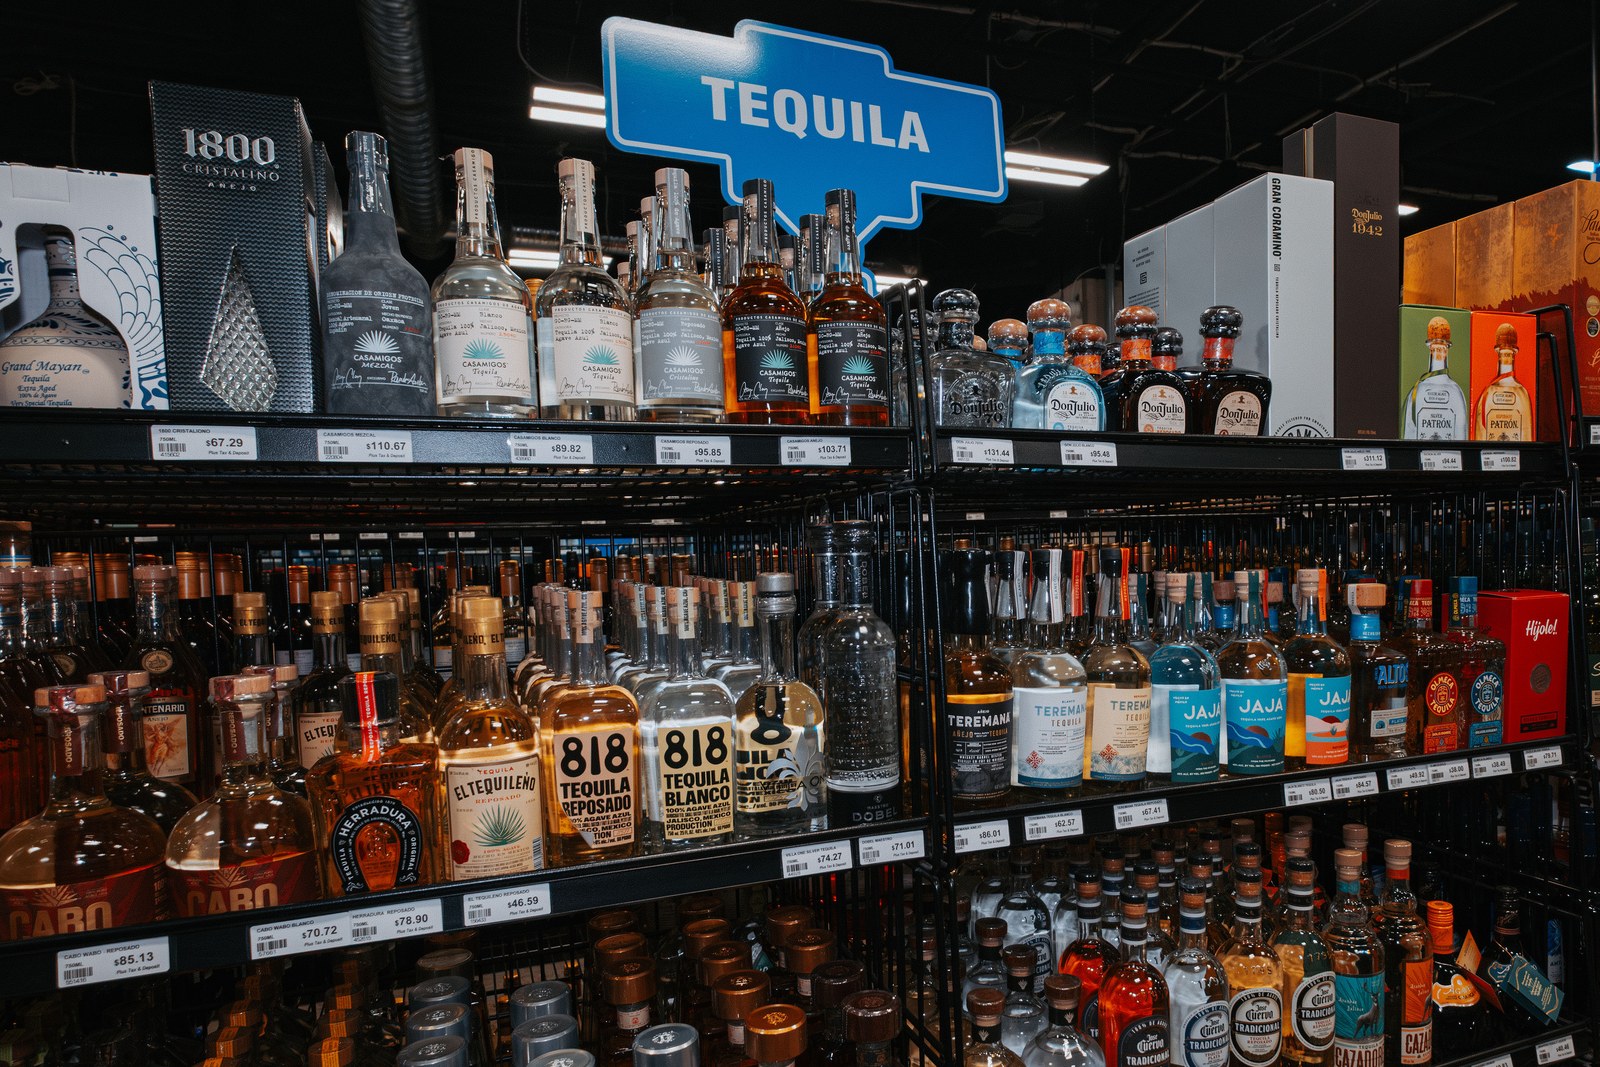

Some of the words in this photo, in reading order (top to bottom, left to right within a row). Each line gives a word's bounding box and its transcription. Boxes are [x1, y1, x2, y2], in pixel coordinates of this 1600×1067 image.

[701, 75, 931, 153] TEQUILA
[181, 127, 276, 166] 1800
[182, 163, 280, 182] CRISTALINO
[1271, 177, 1282, 204] GRAN
[1271, 206, 1282, 258] CORAMINO
[1351, 222, 1383, 236] 1942
[353, 354, 402, 364] CASAMIGOS
[462, 361, 508, 369] CASAMIGOS
[1, 360, 37, 375] Grand
[35, 361, 82, 374] Mayan
[361, 362, 395, 370] MEZCAL
[472, 368, 498, 376] Tequila
[582, 365, 622, 374] CASAMIGOS
[663, 367, 704, 375] CASAMIGOS
[21, 374, 51, 384] Tequila
[592, 372, 616, 381] Tequila
[759, 369, 797, 377] CASAMIGOS
[841, 374, 877, 382] CASAMIGOS
[768, 375, 790, 384] Tequila
[17, 384, 37, 392] Extra
[37, 384, 57, 393] Aged
[47, 399, 72, 407] Tequila
[984, 412, 1003, 423] 70
[1421, 418, 1453, 429] PATRÓN
[1490, 418, 1519, 429] PATRÓN
[206, 437, 244, 448] $67.29
[366, 441, 406, 451] $110.67
[551, 444, 582, 453] $89.82
[694, 448, 722, 457] $95.85
[818, 445, 847, 453] $103.71
[984, 448, 1010, 457] $131.44
[1090, 450, 1111, 458] $95.48
[1363, 454, 1383, 462] $311.12
[1430, 674, 1454, 691] OLMECA
[1475, 674, 1500, 690] OLMECA
[366, 694, 374, 719] TEQUILA
[1034, 703, 1087, 717] TEREMAN
[1239, 697, 1284, 714] JAJA
[1430, 697, 1455, 714] TEQUILA
[1474, 696, 1500, 713] TEQUILA
[1183, 702, 1221, 721] JAJA
[947, 711, 1012, 728] TEREMANA
[1051, 717, 1081, 728] TEQUILA
[229, 710, 238, 748] REPOSADO
[989, 727, 1009, 737] TEQUILA
[663, 726, 728, 770] 818
[560, 733, 629, 778] 818
[477, 766, 514, 775] TEQUILA
[663, 768, 730, 790] TEQUILA
[559, 776, 631, 799] TEQUILA
[475, 793, 521, 805] REPOSADO
[664, 785, 731, 807] BLANCO
[562, 795, 632, 817] REPOSADO
[686, 804, 712, 812] AGAVE
[712, 801, 731, 809] AZUL
[1141, 806, 1161, 816] $67.41
[583, 813, 611, 823] AGAVE
[612, 811, 632, 819] AZUL
[666, 815, 702, 824] JALISCO,
[702, 811, 731, 821] MEXICO
[852, 806, 898, 823] DOBEL
[339, 805, 412, 837] HERRADURA
[666, 820, 713, 831] PRODUCTION
[1054, 819, 1076, 828] $62.57
[979, 829, 1001, 839] $86.01
[891, 841, 916, 851] $71.01
[406, 836, 418, 871] ORIGINAL
[817, 852, 843, 864] $74.27
[339, 847, 354, 881] TEQUILA
[186, 883, 280, 918] CABO
[475, 893, 503, 901] TEQUILENO
[503, 889, 530, 897] REPOSADO
[507, 896, 539, 909] $46.59
[352, 910, 385, 919] HERRADURA
[386, 906, 415, 915] REPOSADO
[9, 901, 113, 941] CABO
[273, 923, 291, 931] WABO
[291, 919, 315, 928] BLANCO
[394, 913, 428, 927] $78.90
[302, 925, 338, 939] $70.72
[106, 944, 140, 954] REPOSADO
[114, 951, 154, 967] $85.13
[142, 963, 161, 971] Deposit
[1245, 1008, 1274, 1022] Cuervo
[1200, 1024, 1226, 1037] Cuervo
[1234, 1021, 1280, 1036] TRADICIONAL
[1136, 1039, 1165, 1053] Cuervo
[1358, 1042, 1379, 1050] TEQUILA
